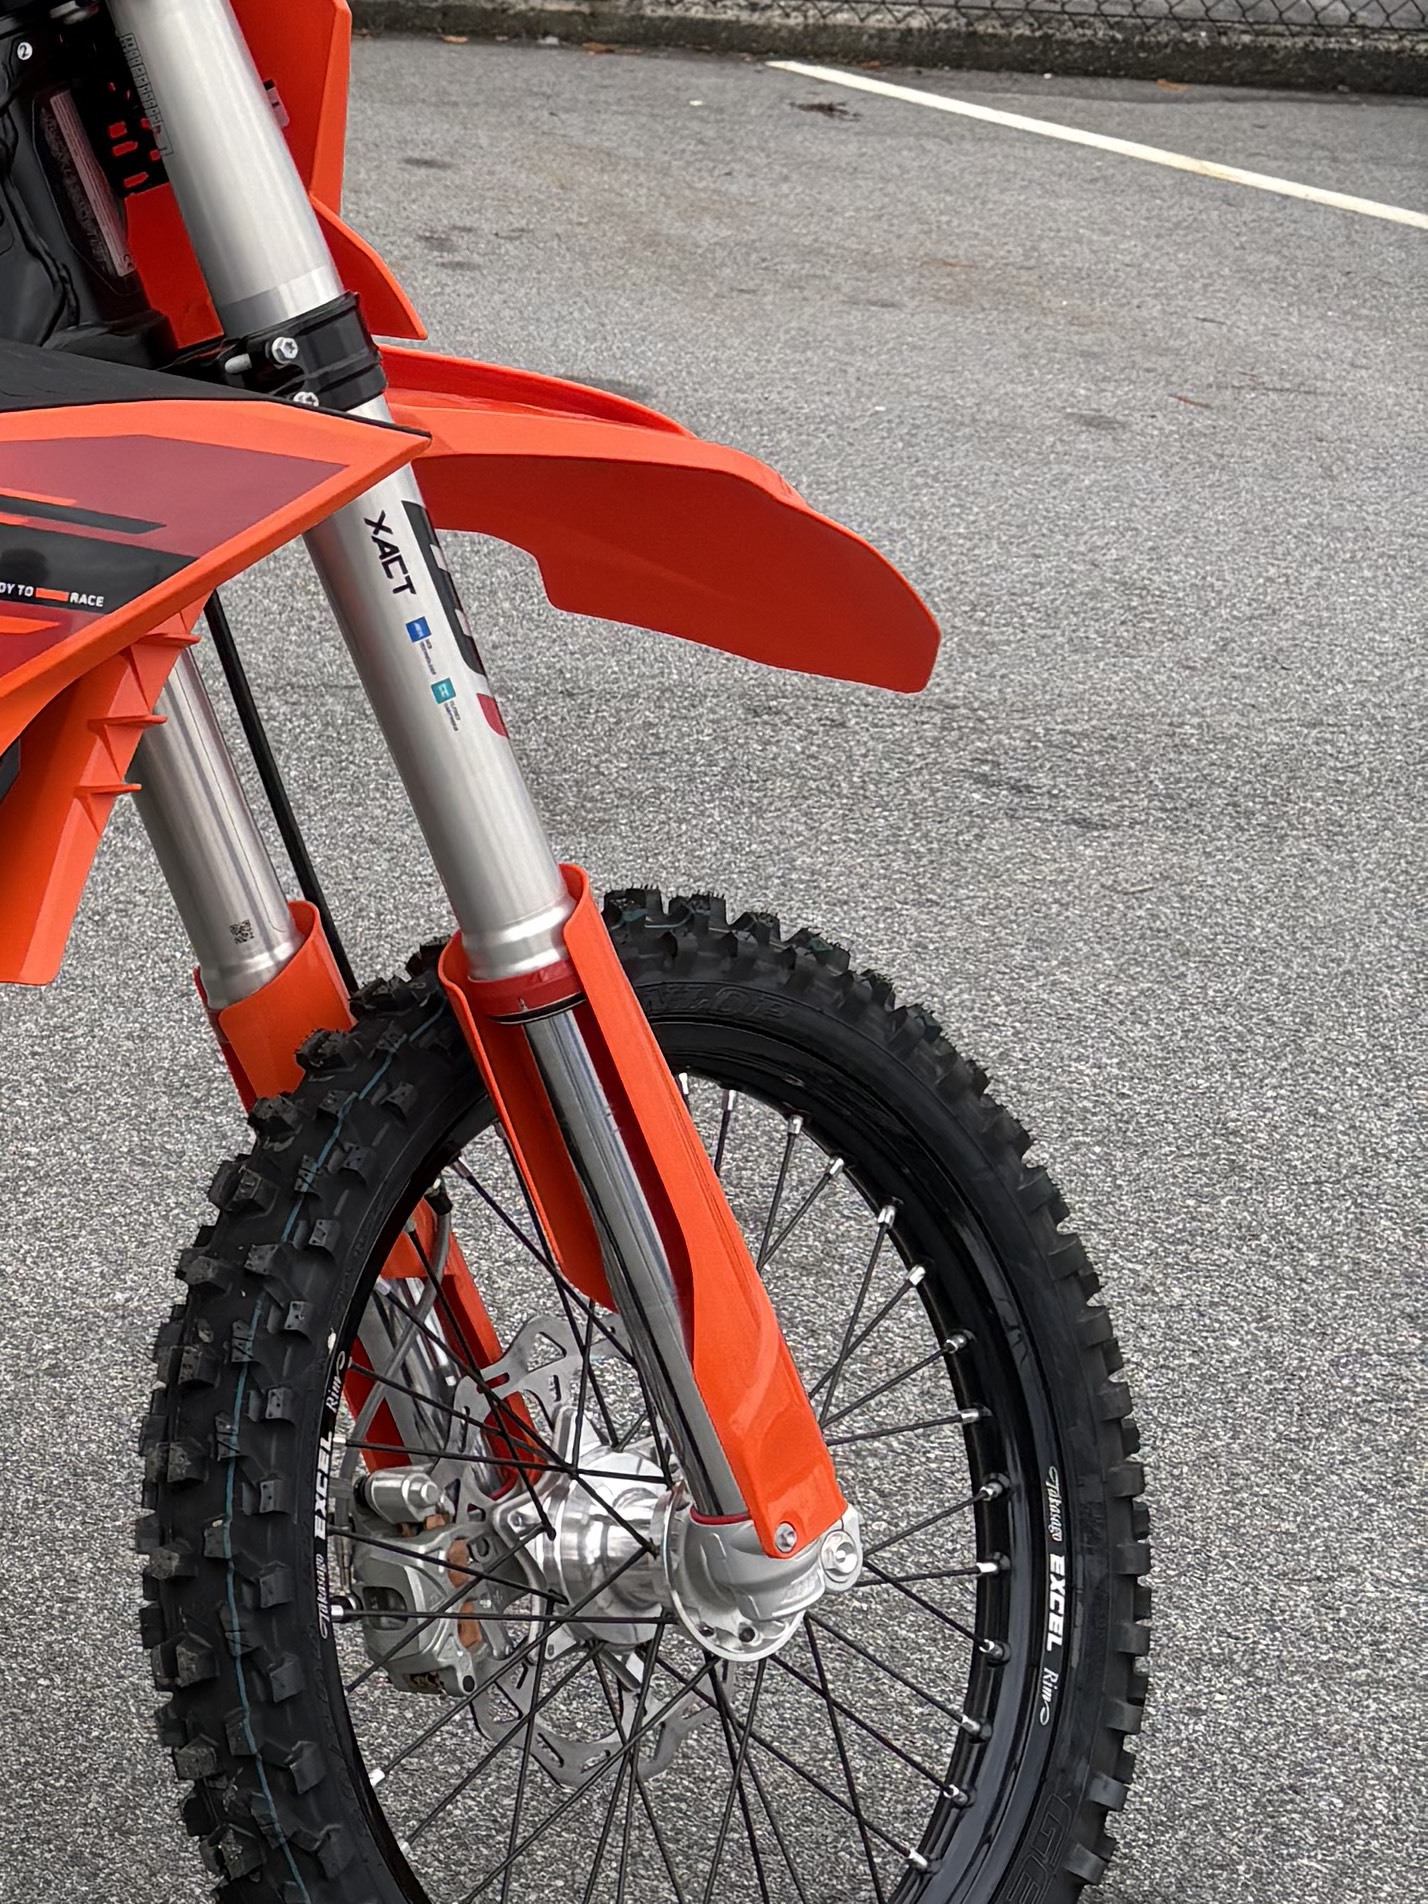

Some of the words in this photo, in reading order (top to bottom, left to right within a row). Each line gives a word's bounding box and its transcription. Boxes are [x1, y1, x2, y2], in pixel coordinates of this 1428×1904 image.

[18, 43, 30, 59] 2
[363, 509, 416, 595] XACT
[17, 584, 34, 597] TO
[69, 592, 105, 608] RACE
[314, 1430, 334, 1540] EXCEL
[325, 1350, 345, 1414] Rim
[1046, 1553, 1066, 1652] EXCEL
[1039, 1666, 1060, 1726] Rim
